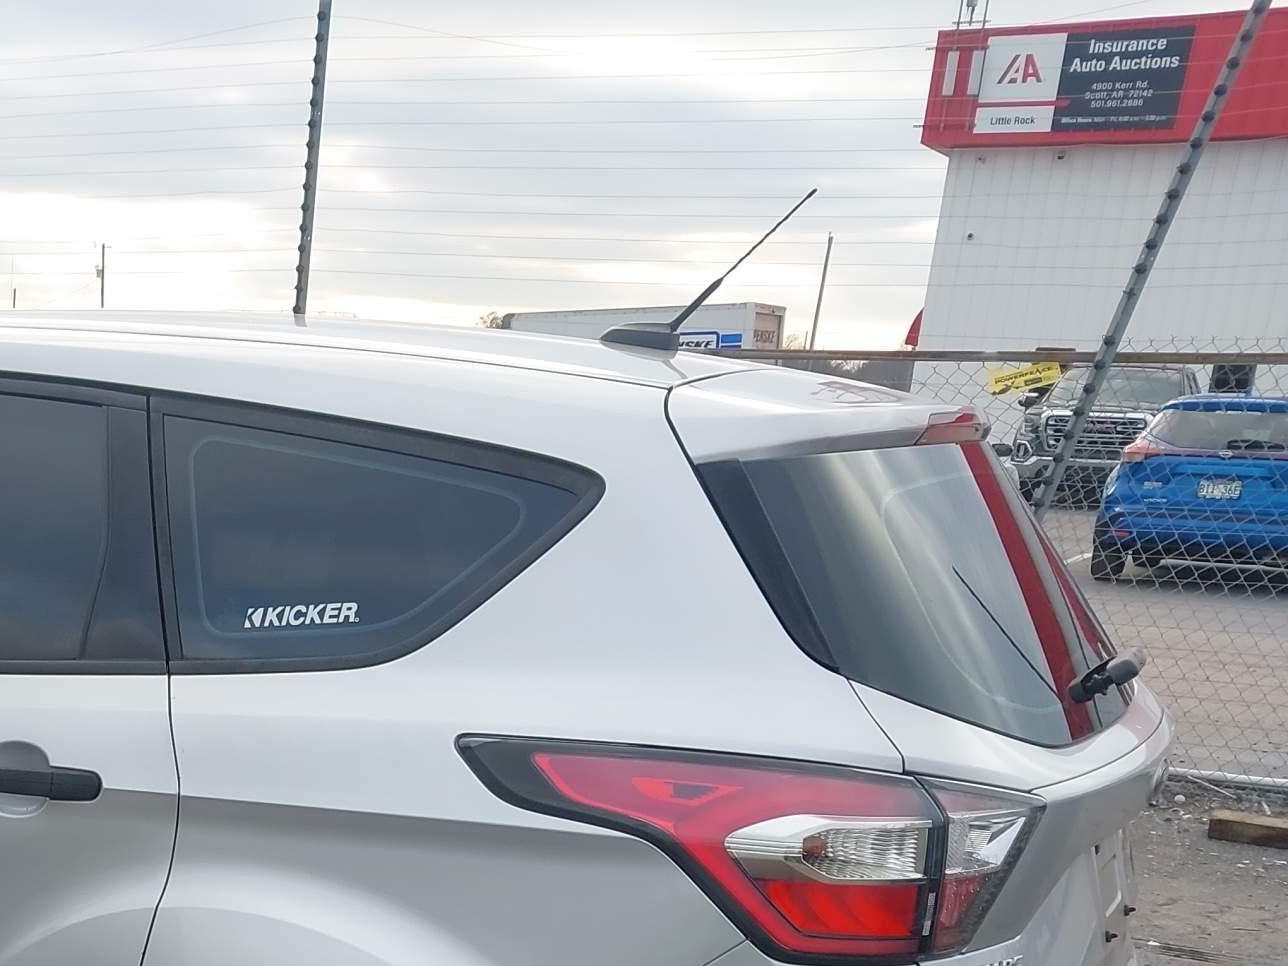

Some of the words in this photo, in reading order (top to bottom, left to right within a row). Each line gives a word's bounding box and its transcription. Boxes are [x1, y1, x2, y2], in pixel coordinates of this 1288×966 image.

[1088, 38, 1168, 54] Insurance
[1070, 57, 1106, 73] Auto
[1109, 54, 1181, 71] Auctions
[1091, 82, 1113, 90] 4900
[1114, 81, 1133, 90] Kerr
[1135, 80, 1150, 88] Rd.
[1084, 92, 1109, 100] Scott,
[1128, 89, 1153, 98] 72142
[990, 115, 1012, 126] Little
[1013, 115, 1036, 125] Rock
